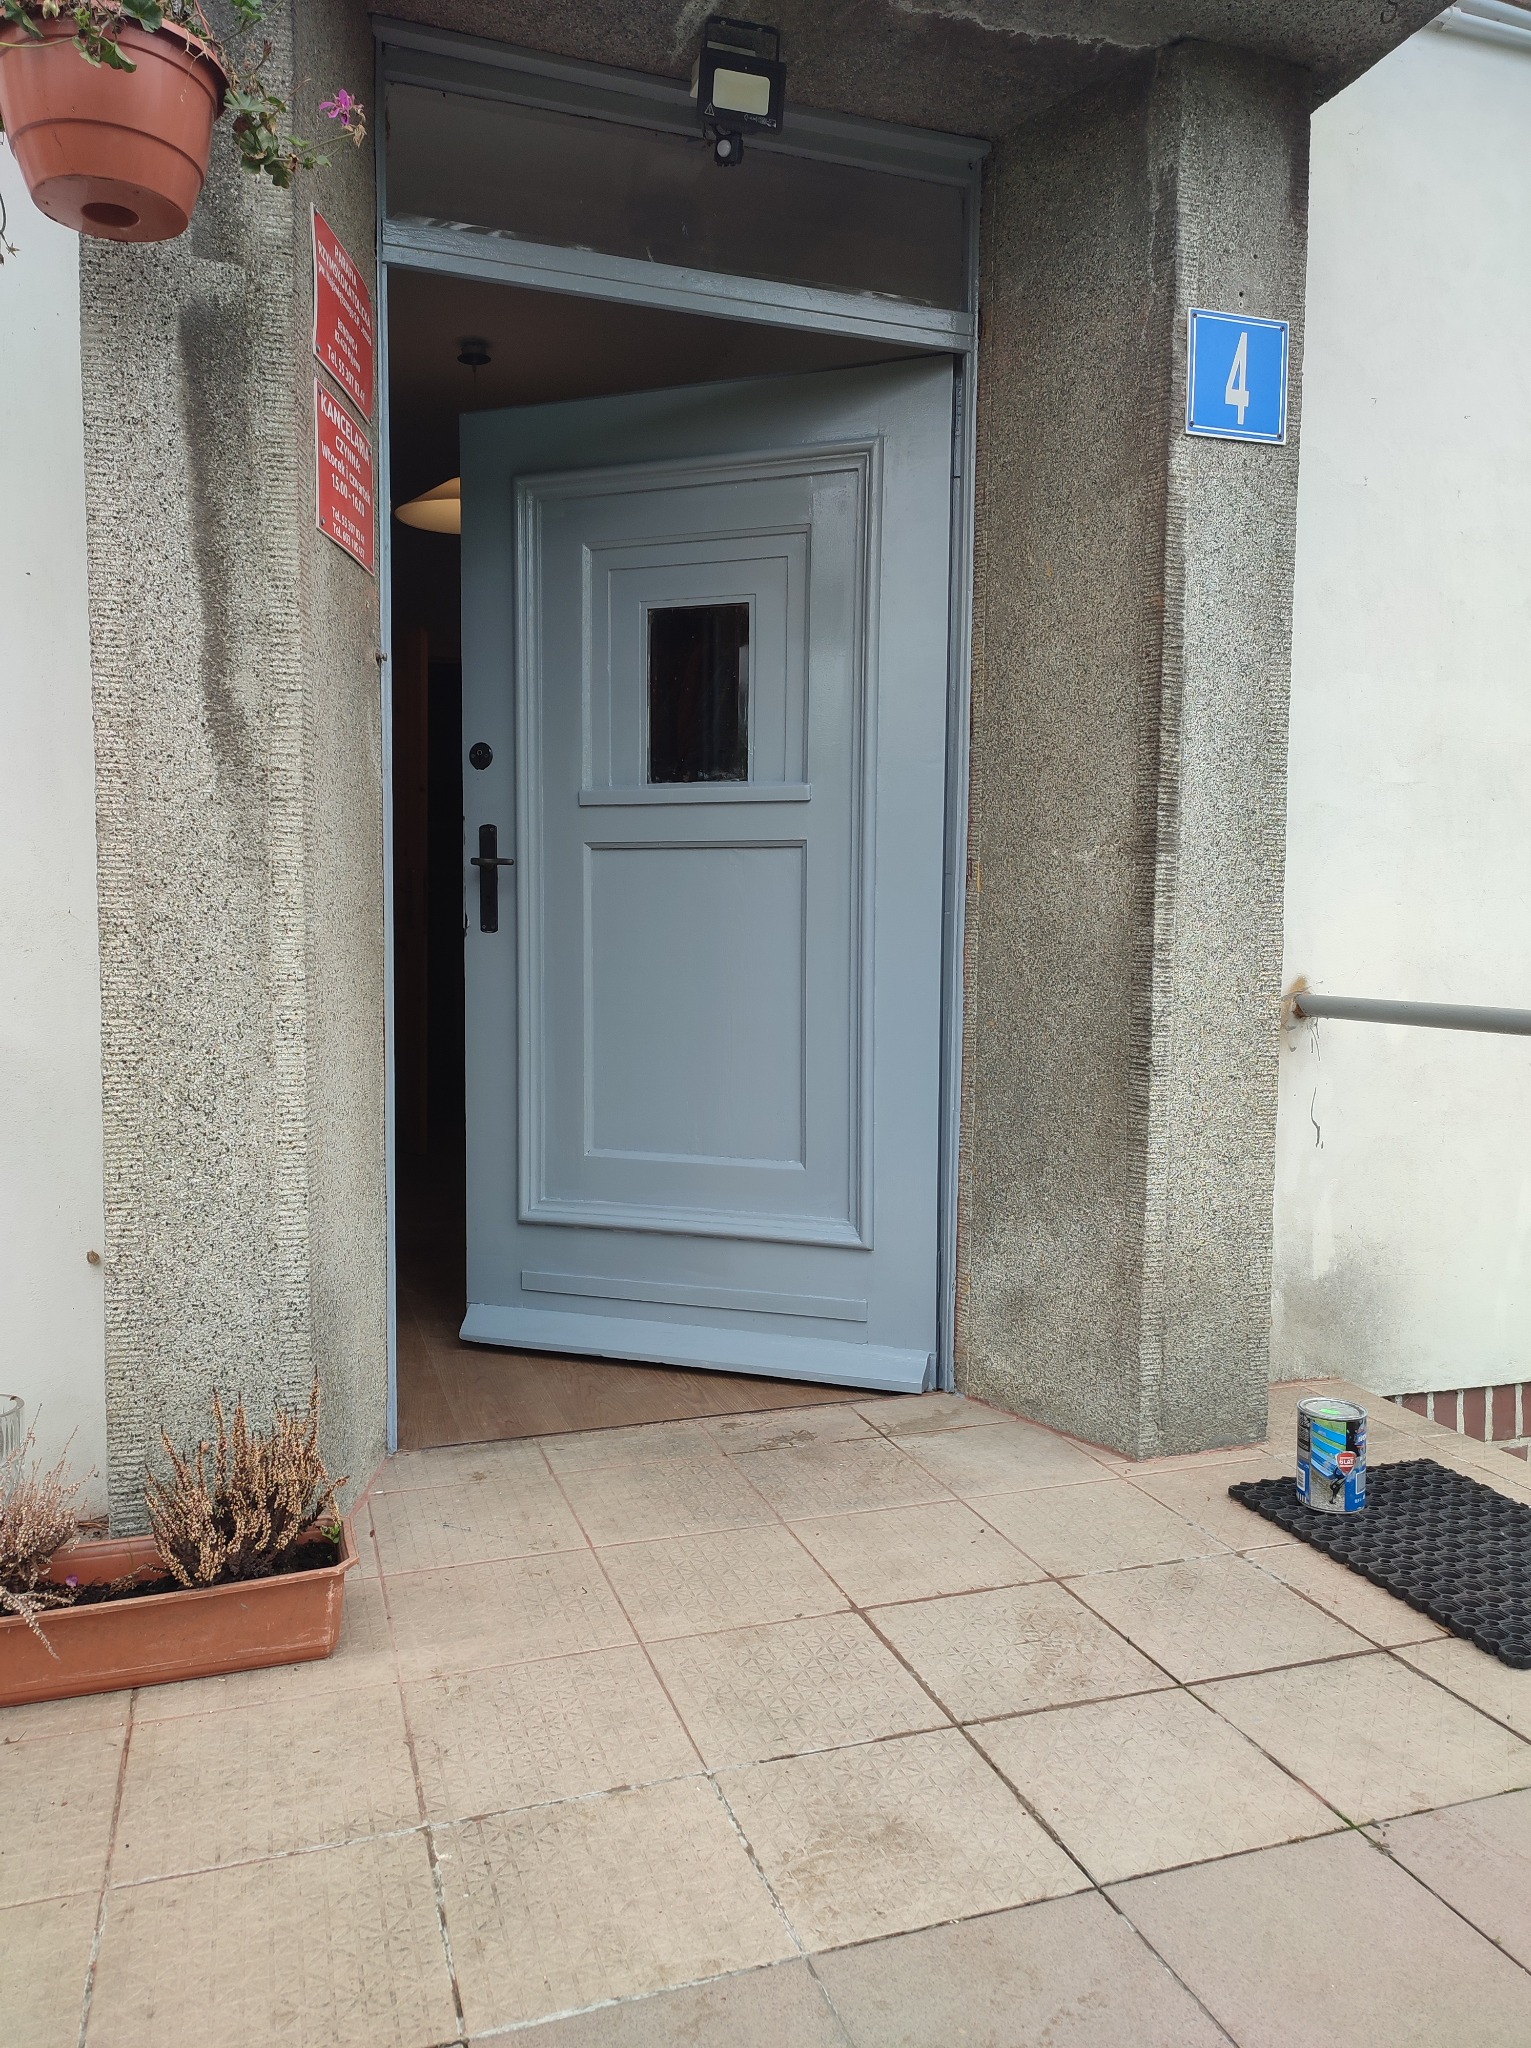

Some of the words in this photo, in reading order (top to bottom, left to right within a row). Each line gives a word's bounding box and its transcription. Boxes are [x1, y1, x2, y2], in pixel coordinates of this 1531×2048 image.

[334, 244, 357, 290] PARAFIA
[1224, 331, 1250, 405] 4
[320, 393, 369, 465] KANCELARIA
[331, 473, 347, 499] 15.00
